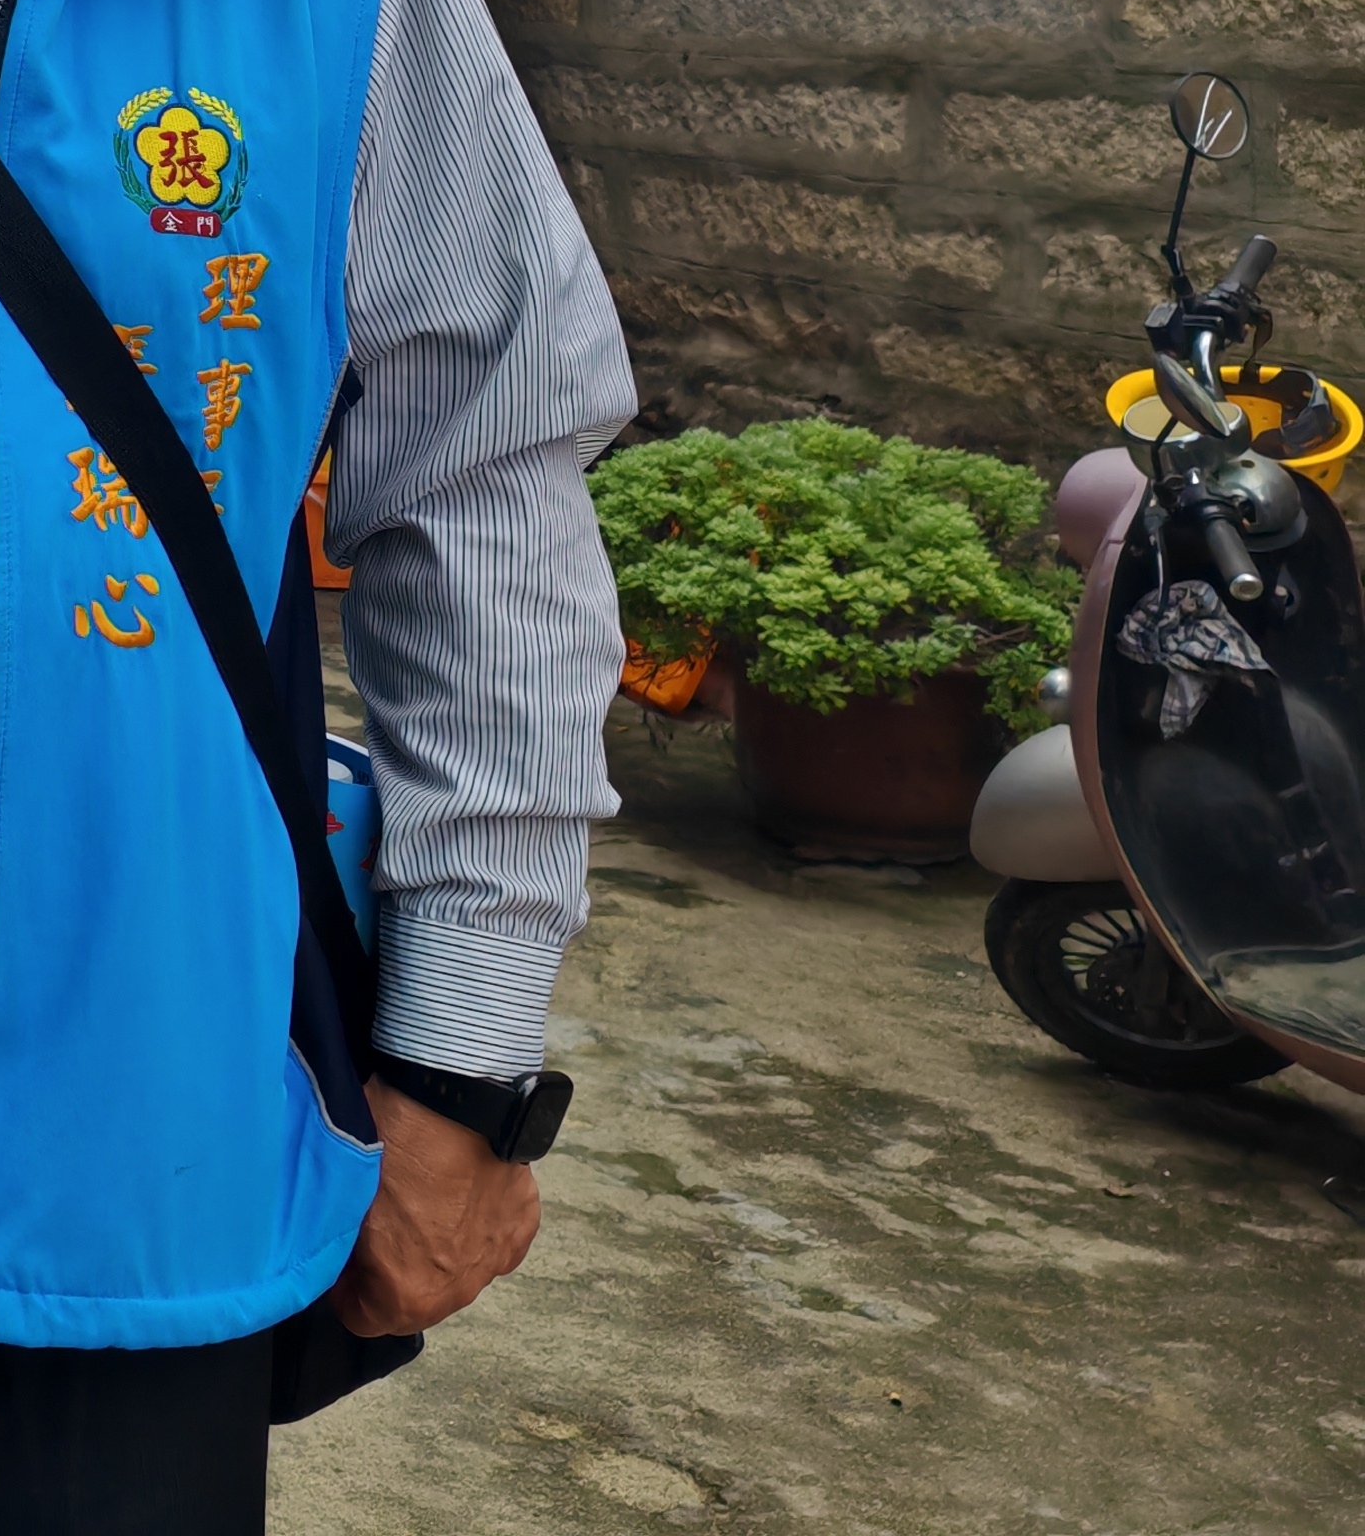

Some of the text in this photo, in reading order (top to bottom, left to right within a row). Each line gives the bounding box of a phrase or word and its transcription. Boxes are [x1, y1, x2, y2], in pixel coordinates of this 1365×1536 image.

[158, 128, 215, 189] 張
[160, 210, 214, 237] 金門
[197, 252, 271, 516] 理事
